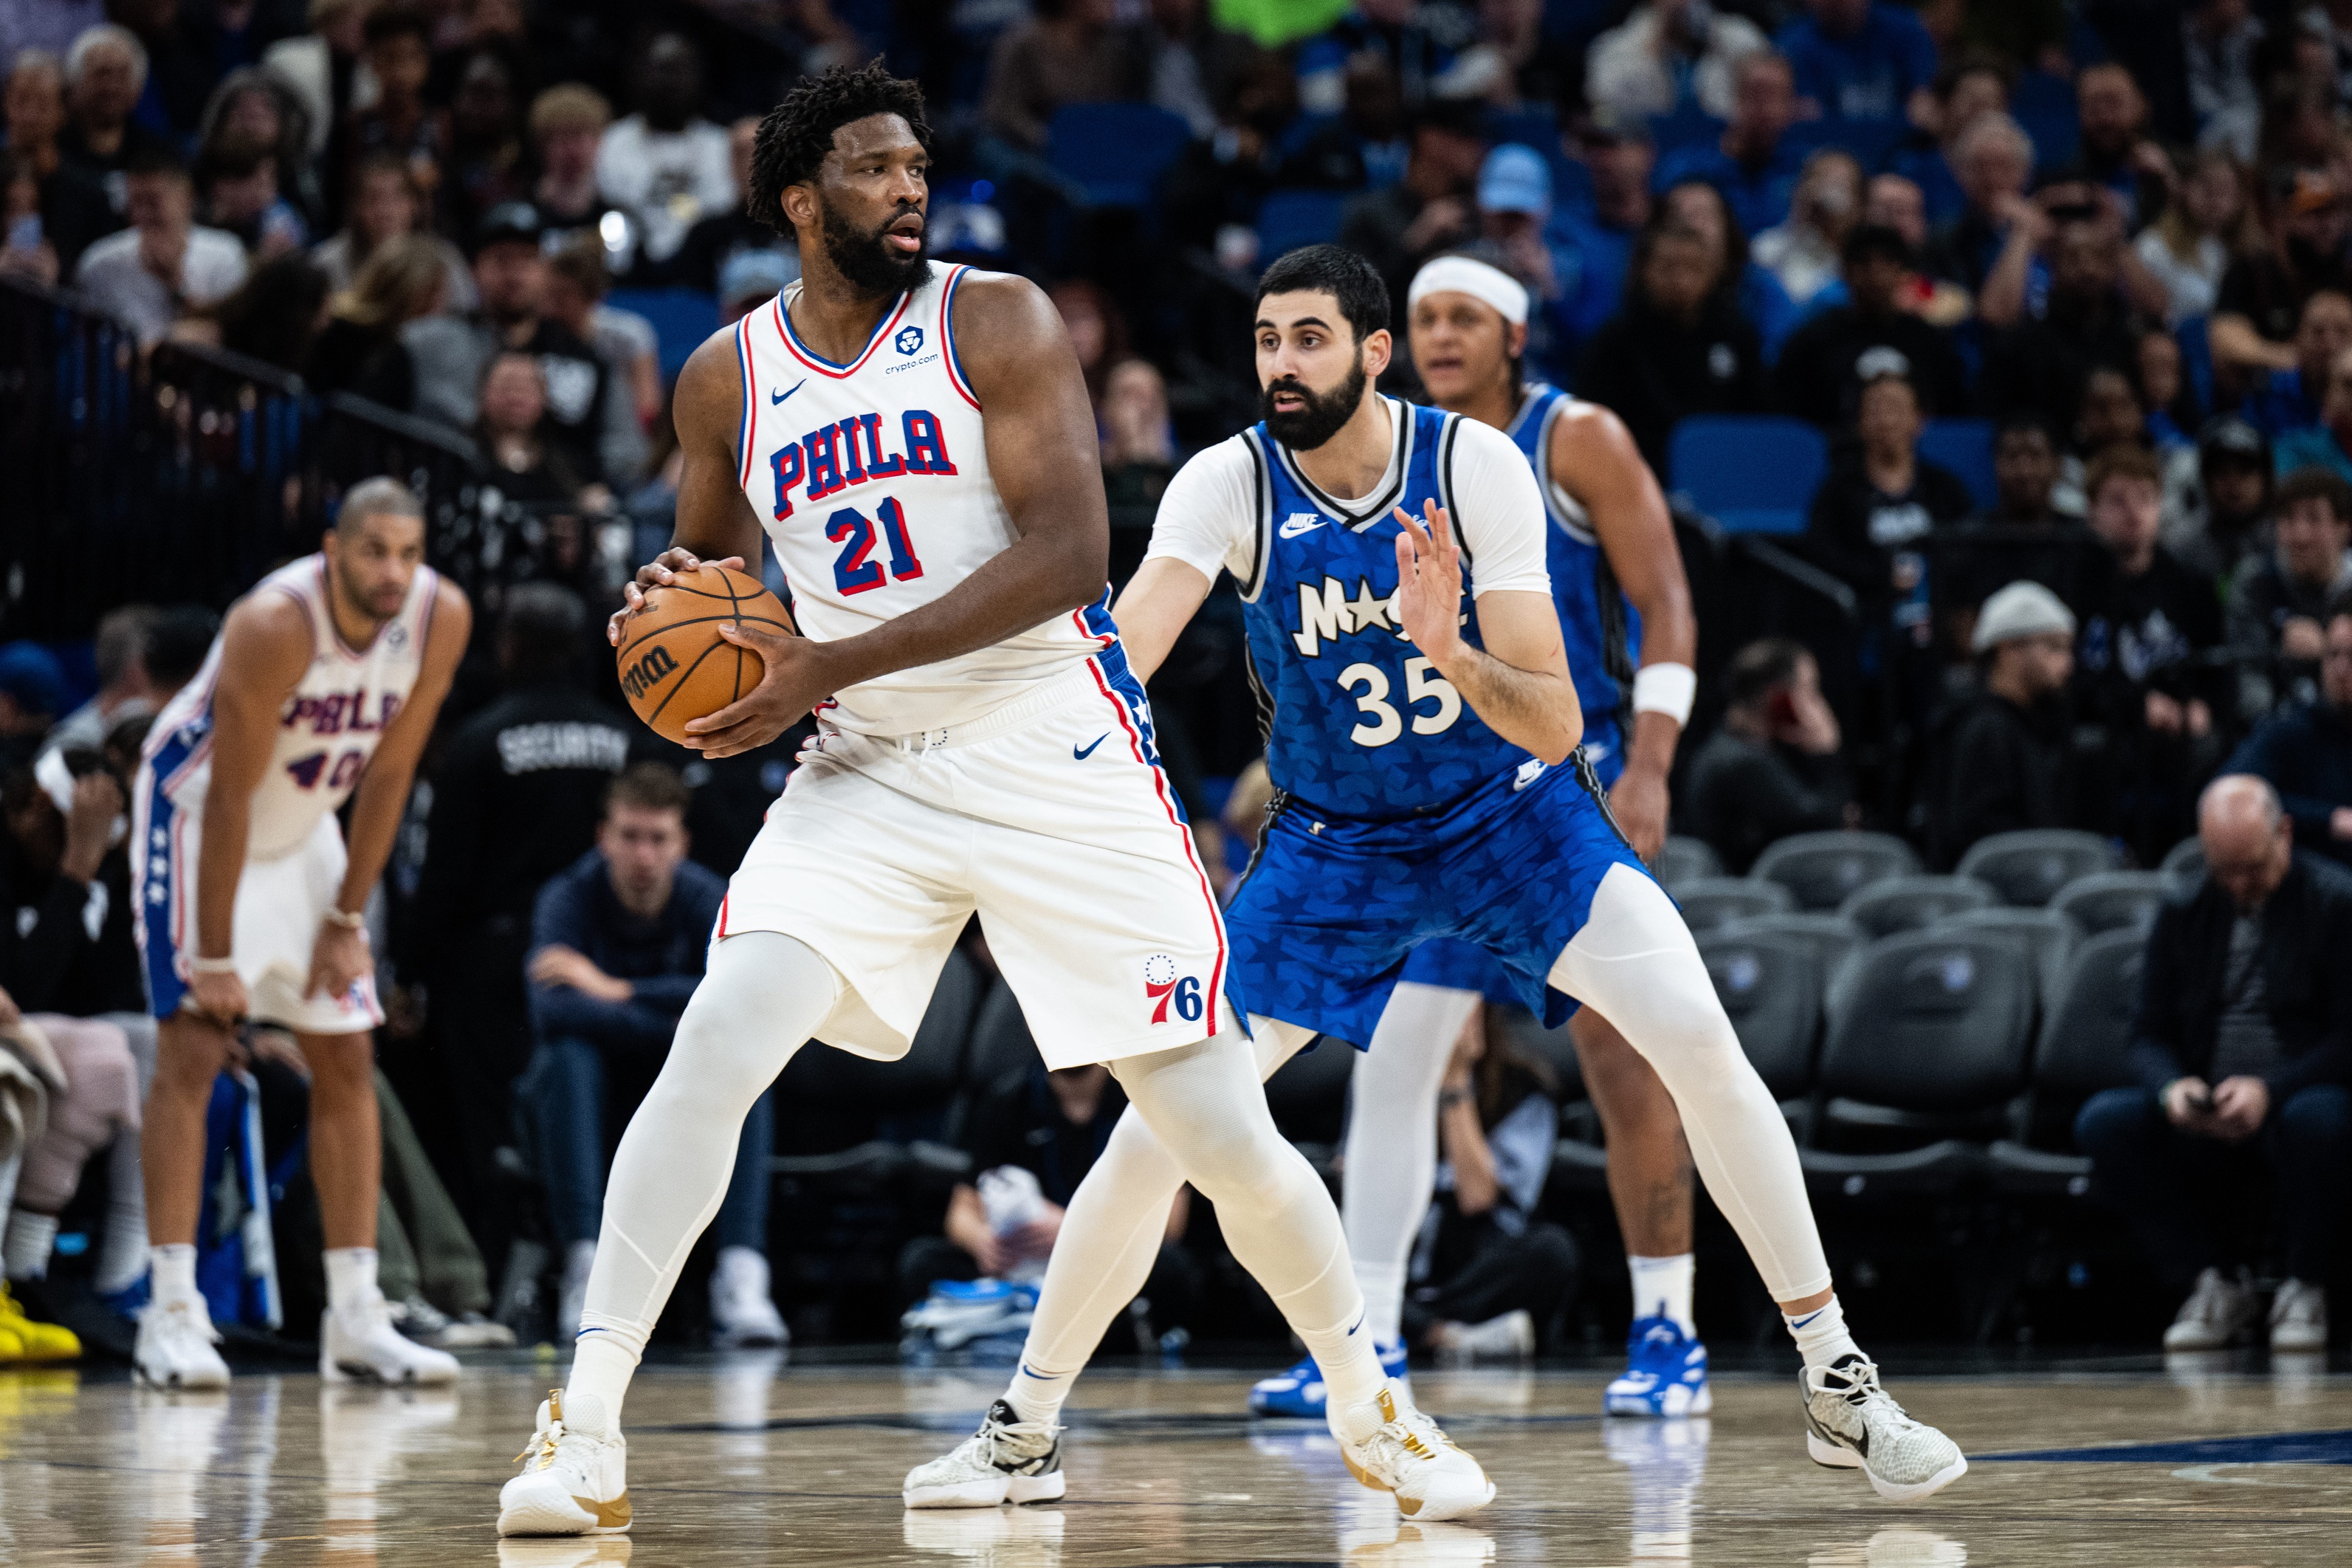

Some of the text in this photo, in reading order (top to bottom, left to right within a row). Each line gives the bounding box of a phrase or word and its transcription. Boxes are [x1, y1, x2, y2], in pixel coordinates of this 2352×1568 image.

[885, 354, 938, 374] crypto.com
[770, 410, 958, 522] PHILA
[825, 495, 924, 596] 21
[1287, 512, 1319, 528] NIKE
[621, 644, 680, 701] Wils
[1337, 656, 1462, 747] 35
[286, 752, 363, 790] 40
[1145, 975, 1203, 1025] 76
